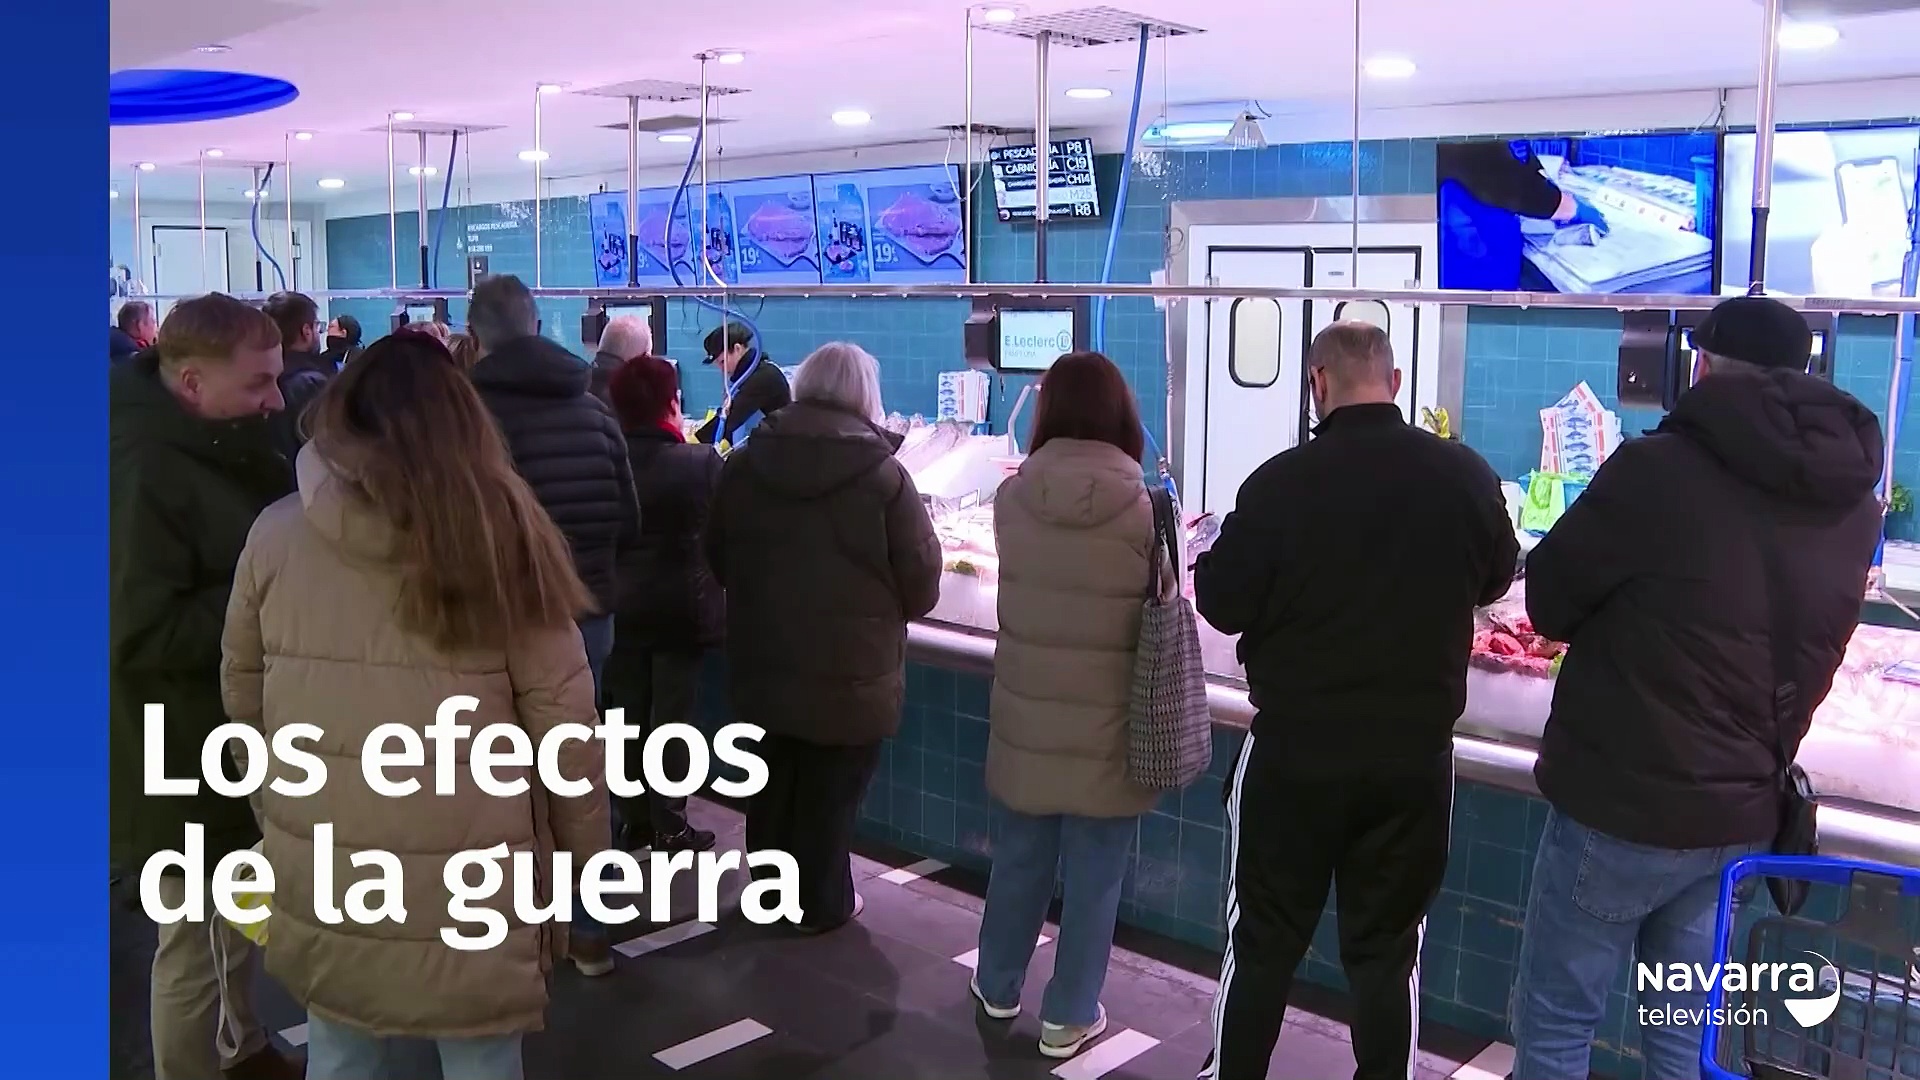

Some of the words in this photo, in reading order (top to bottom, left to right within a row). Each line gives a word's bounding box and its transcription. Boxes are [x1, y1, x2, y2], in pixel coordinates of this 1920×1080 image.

[1066, 141, 1083, 154] P8
[1066, 157, 1087, 171] C19
[1067, 173, 1090, 185] CH14
[1069, 187, 1093, 200] M25
[1074, 203, 1092, 216] R8
